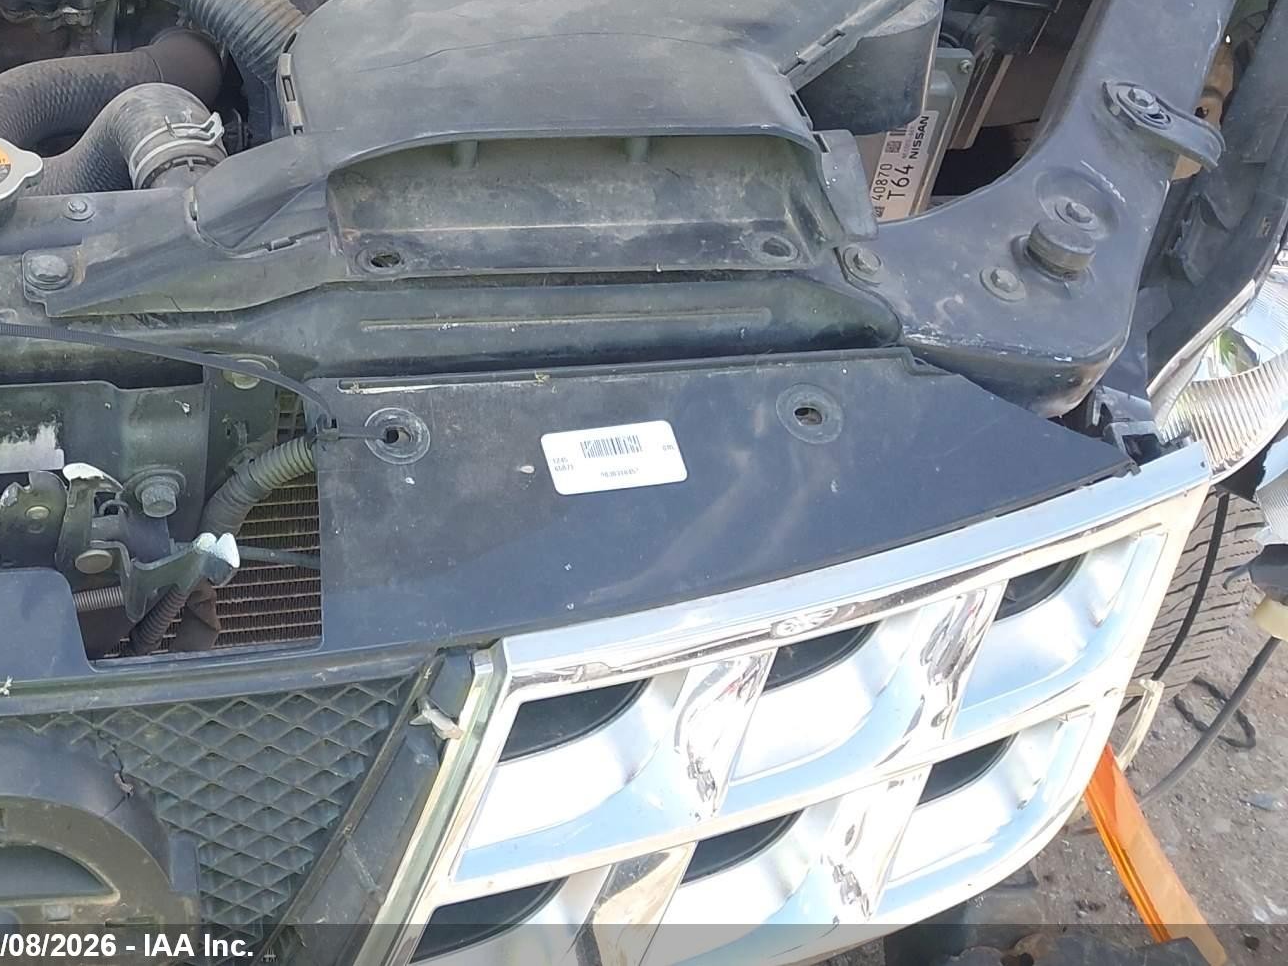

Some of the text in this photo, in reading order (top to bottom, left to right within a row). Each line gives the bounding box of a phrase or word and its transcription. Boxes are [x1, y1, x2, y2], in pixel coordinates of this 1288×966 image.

[908, 116, 929, 160] NISSAN
[871, 163, 893, 201] 40870
[886, 164, 915, 200] T64
